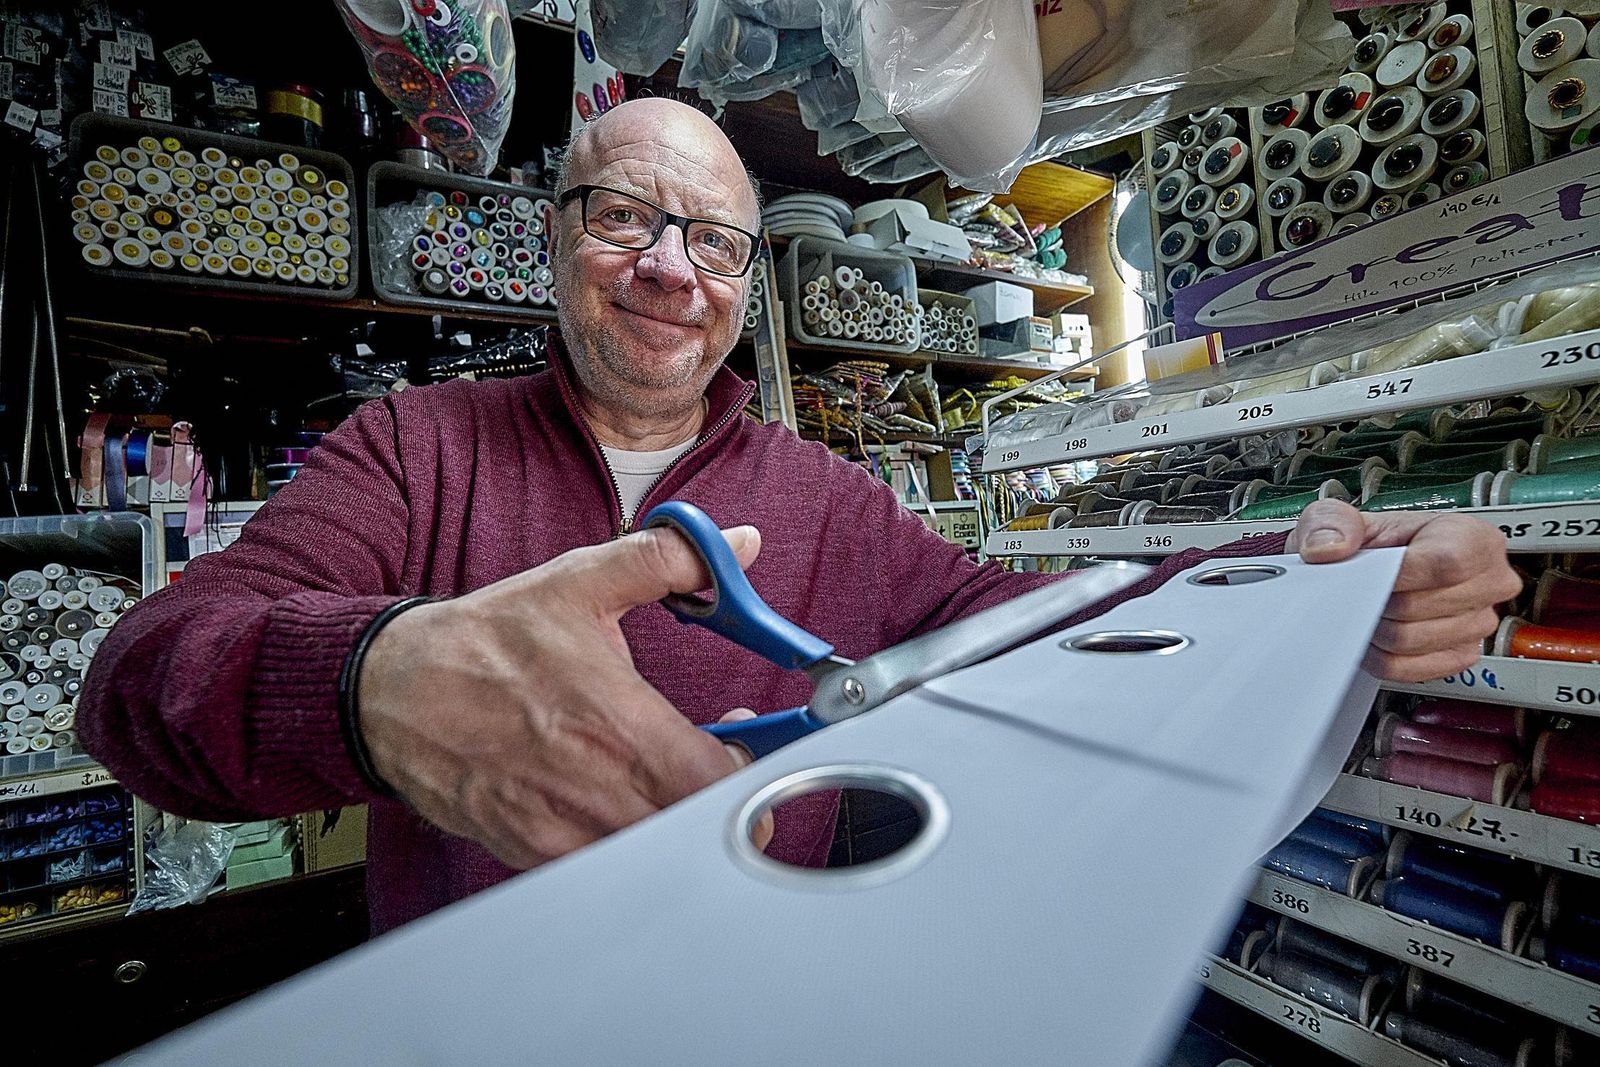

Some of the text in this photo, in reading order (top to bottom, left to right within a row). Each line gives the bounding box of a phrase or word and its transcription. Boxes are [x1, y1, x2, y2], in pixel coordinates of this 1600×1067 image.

[1389, 264, 1457, 289] 100%
[1471, 231, 1591, 268] Poliester
[1541, 342, 1600, 369] 230
[1367, 378, 1413, 399] 547
[1238, 403, 1274, 421] 205
[1142, 423, 1169, 438] 201
[1065, 438, 1087, 451] 198
[1001, 451, 1020, 463] 199
[1541, 519, 1600, 537] 252
[1004, 537, 1023, 549] 183
[1067, 538, 1090, 549] 339
[1143, 535, 1172, 548] 346
[1555, 685, 1600, 705] 50
[1395, 806, 1441, 828] 140
[1272, 889, 1310, 914] 386
[1406, 938, 1455, 968] 387
[1283, 1004, 1321, 1034] 278
